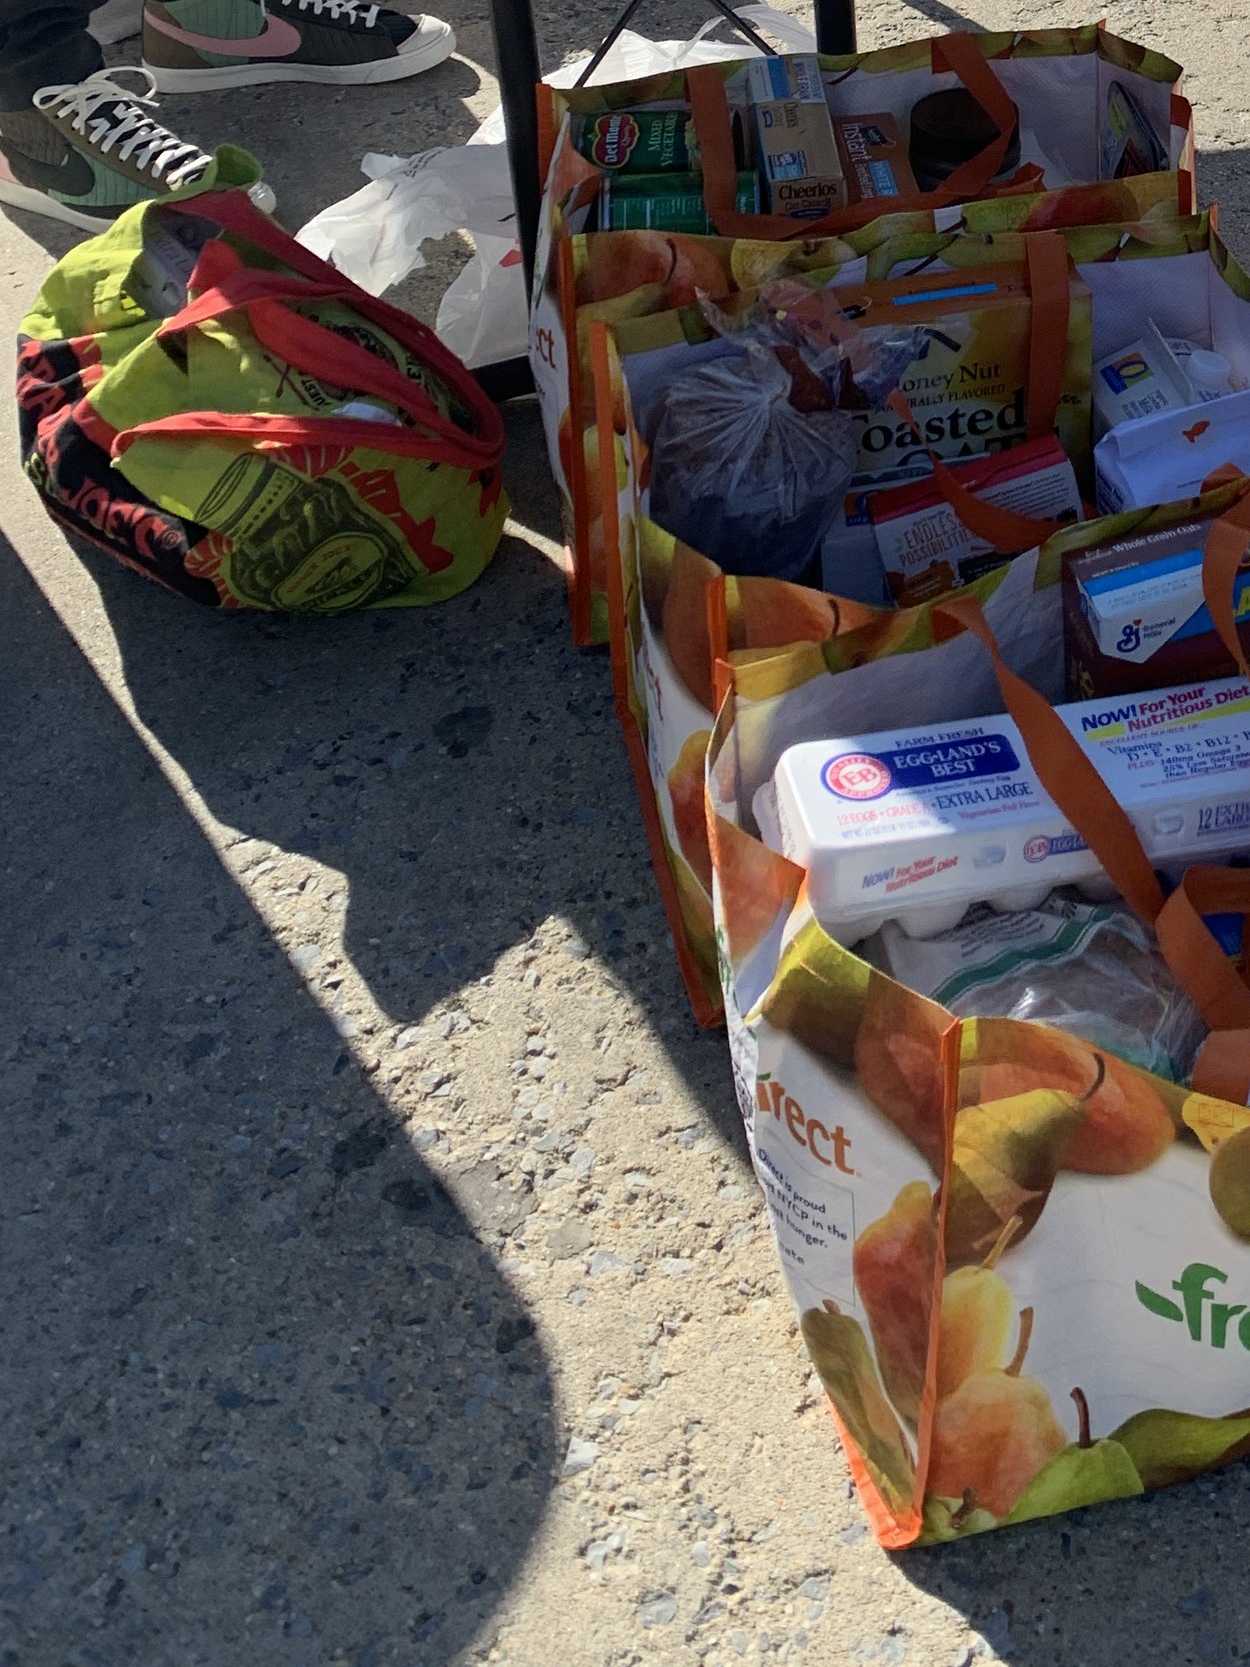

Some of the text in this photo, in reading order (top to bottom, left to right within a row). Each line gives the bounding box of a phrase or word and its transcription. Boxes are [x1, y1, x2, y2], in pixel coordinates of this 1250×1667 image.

[605, 115, 622, 163] Del Monte
[648, 119, 663, 151] MIXED
[842, 123, 872, 162] Instant
[778, 183, 837, 201] Cheerios
[901, 363, 1002, 392] oney Nut
[948, 384, 1005, 401] FLAVORED
[900, 528, 972, 568] POSSIBILITIE
[1113, 524, 1202, 554] Whole Grain Oats
[1143, 617, 1176, 633] General
[1081, 687, 1206, 732] NOW! For Your
[1126, 685, 1250, 733] Nutritious Diet
[894, 727, 984, 748] FARM FRESH
[1107, 740, 1163, 755] Vitamins
[1128, 752, 1140, 762] D
[1153, 749, 1164, 758] E
[1175, 743, 1194, 754] B2
[1204, 735, 1232, 747] B12
[1196, 747, 1232, 759] Omega
[842, 766, 878, 787] EB
[931, 758, 976, 778] BEST
[1163, 764, 1184, 774] 25%
[1189, 762, 1228, 775] Regular
[836, 814, 848, 826] 12
[886, 803, 921, 818] GRADE
[936, 789, 985, 810] EXTRA
[988, 781, 1033, 801] LARGE
[1198, 808, 1212, 832] 12
[862, 867, 895, 889] NOW!
[913, 855, 937, 870] Your
[793, 1190, 826, 1214] proud
[811, 1215, 824, 1229] in
[827, 1221, 848, 1240] the
